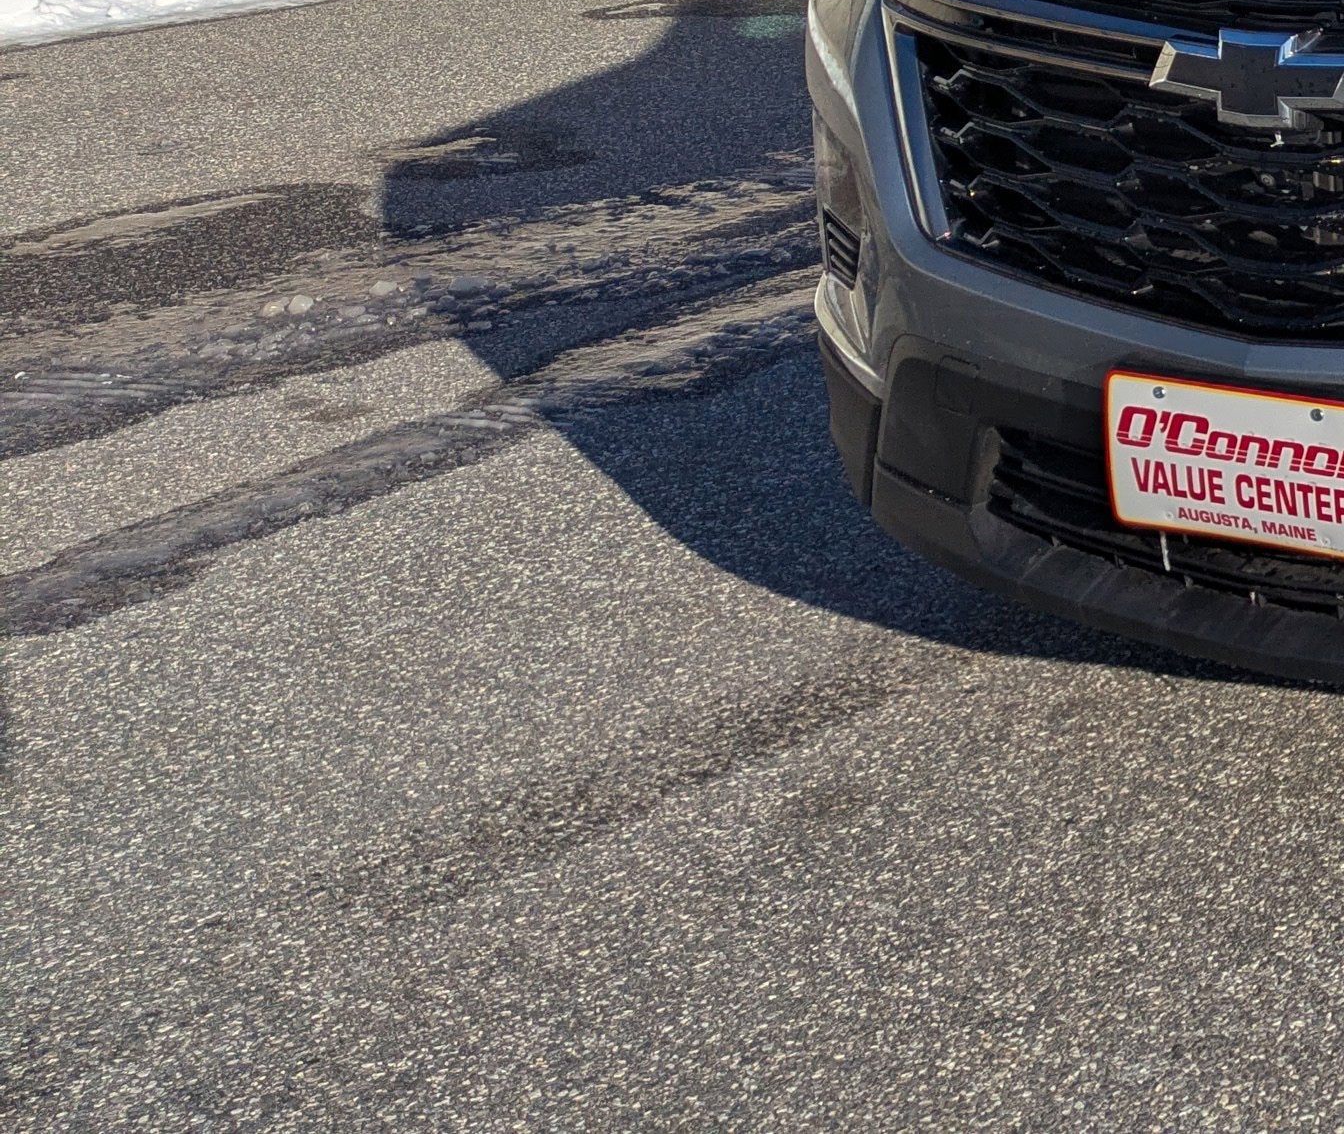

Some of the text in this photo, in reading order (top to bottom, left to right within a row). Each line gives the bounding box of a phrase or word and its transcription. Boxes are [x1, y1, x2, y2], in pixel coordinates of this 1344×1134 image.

[1131, 457, 1226, 505] VALUE
[1177, 507, 1317, 542] AUGUSTA, MAINE
